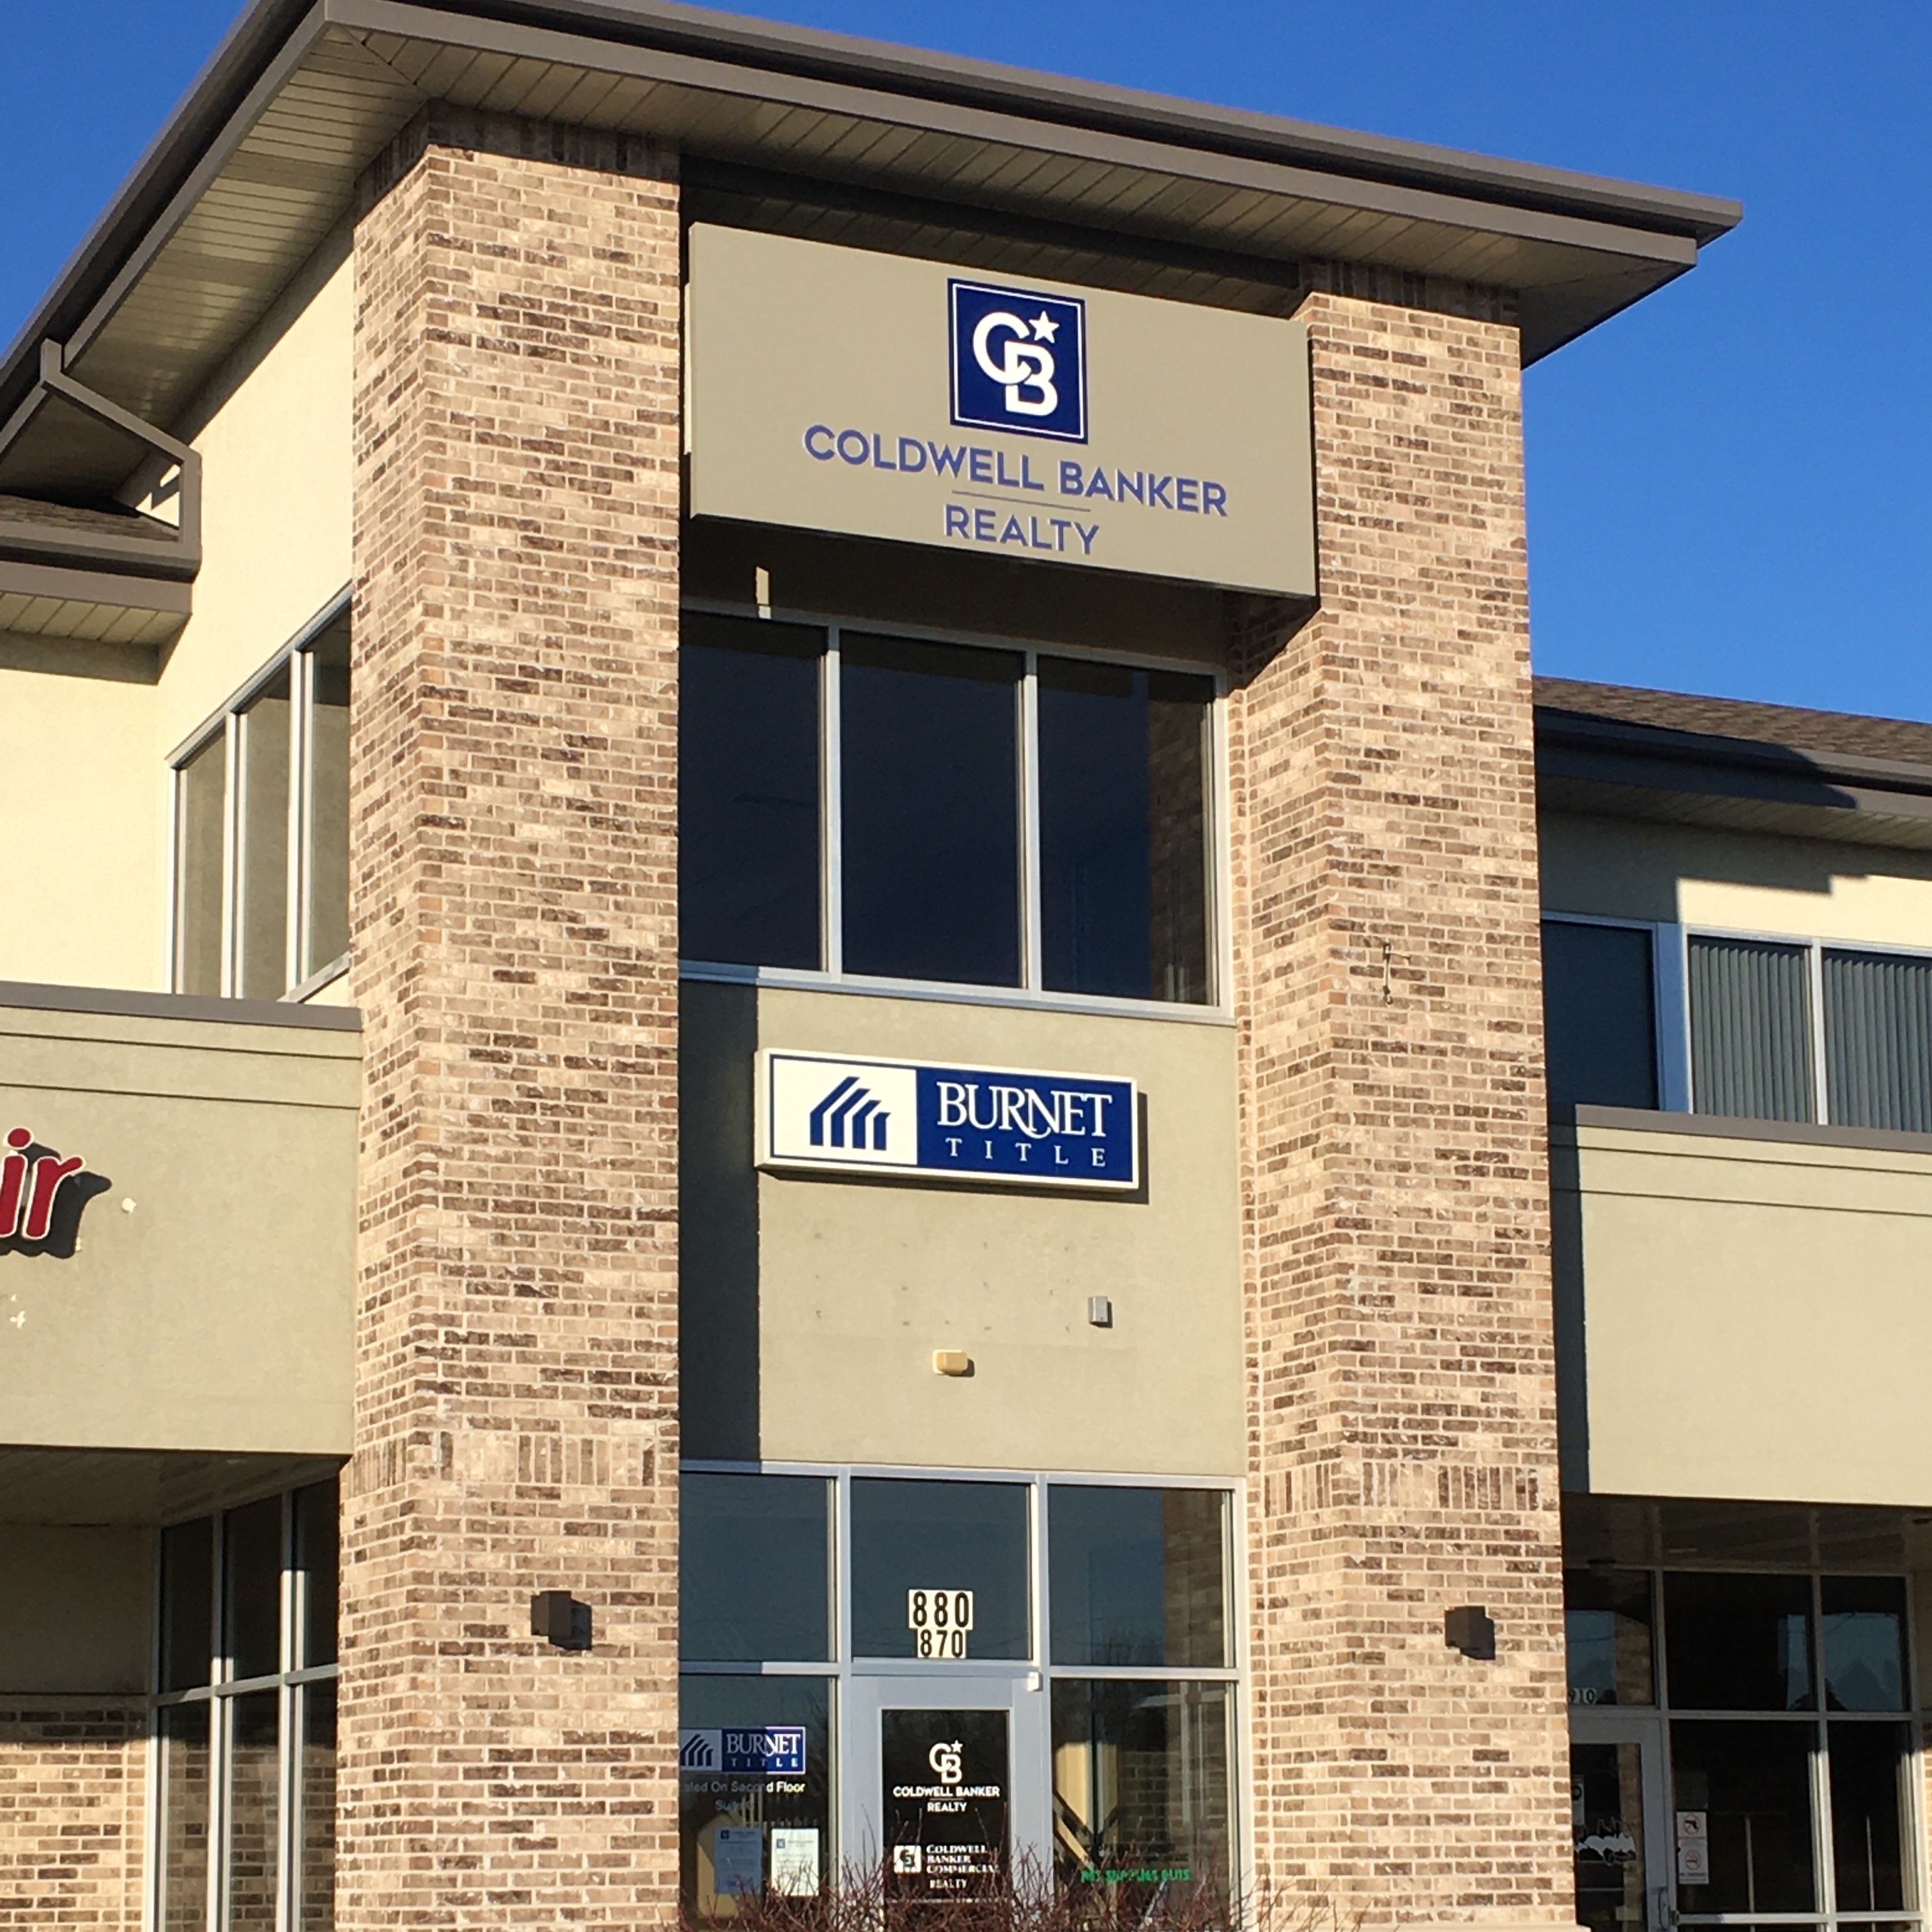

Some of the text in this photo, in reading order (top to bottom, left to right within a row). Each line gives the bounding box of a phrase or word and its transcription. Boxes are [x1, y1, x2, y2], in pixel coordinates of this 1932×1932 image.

[802, 424, 1229, 517] COLDWELL BANKER
[943, 504, 1100, 555] REALTY
[936, 1081, 1112, 1139] BURNET
[946, 1137, 1106, 1167] TITLE
[912, 1590, 970, 1628] 880
[919, 1629, 964, 1658] 870
[726, 1733, 801, 1757] BURNET
[730, 1757, 799, 1768] TITLE
[710, 1781, 728, 1793] On
[730, 1781, 774, 1793] Second
[776, 1781, 806, 1793] Floor
[893, 1785, 1000, 1798] COLDWELL BANKER
[927, 1801, 967, 1813] REALTY
[926, 1844, 988, 1853] COLDWELL
[926, 1855, 972, 1864] BANKER
[930, 1878, 968, 1889] REALTY
